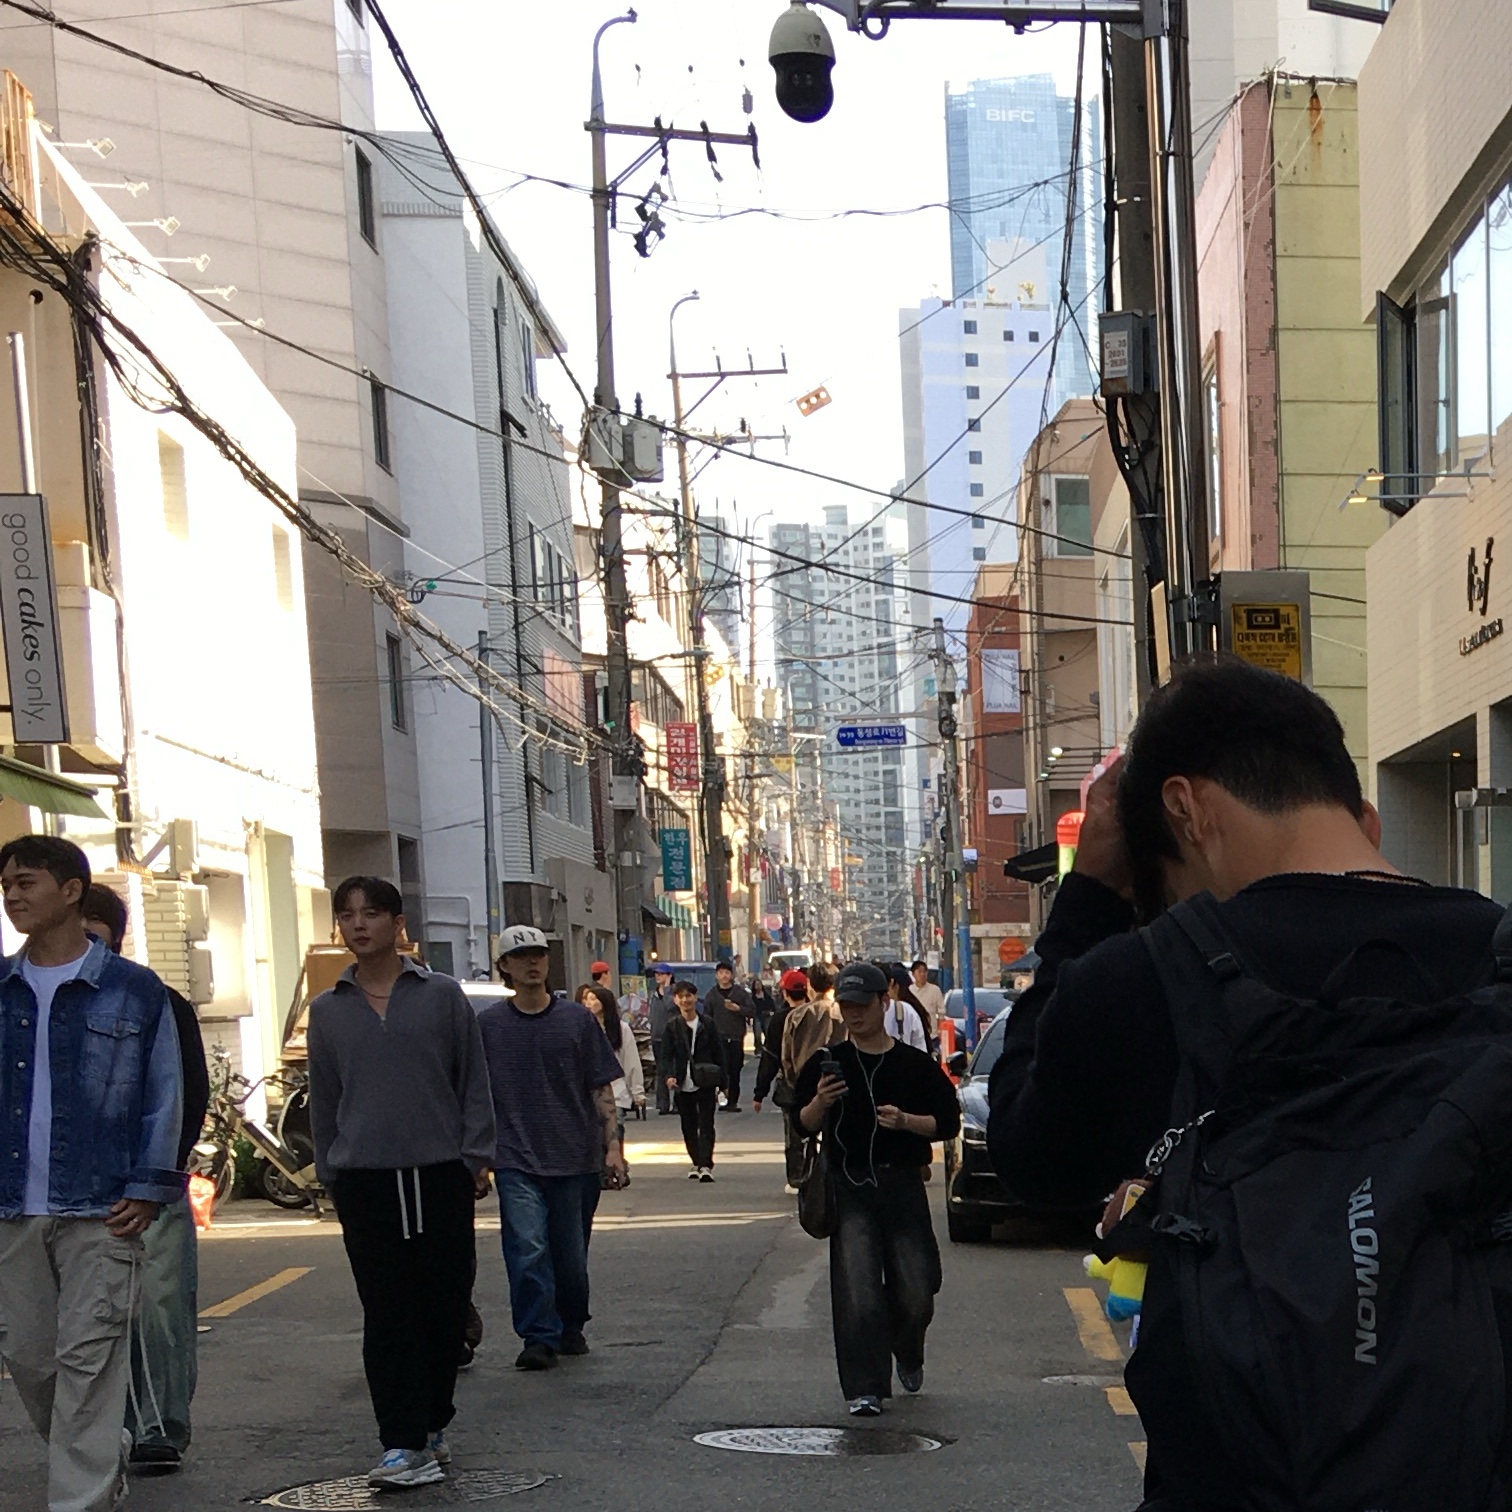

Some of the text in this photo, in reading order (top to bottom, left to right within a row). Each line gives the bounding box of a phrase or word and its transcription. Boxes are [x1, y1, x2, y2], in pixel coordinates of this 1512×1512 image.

[986, 108, 1036, 123] BIFC
[2, 513, 52, 725] good cakes only.
[513, 931, 538, 945] NY
